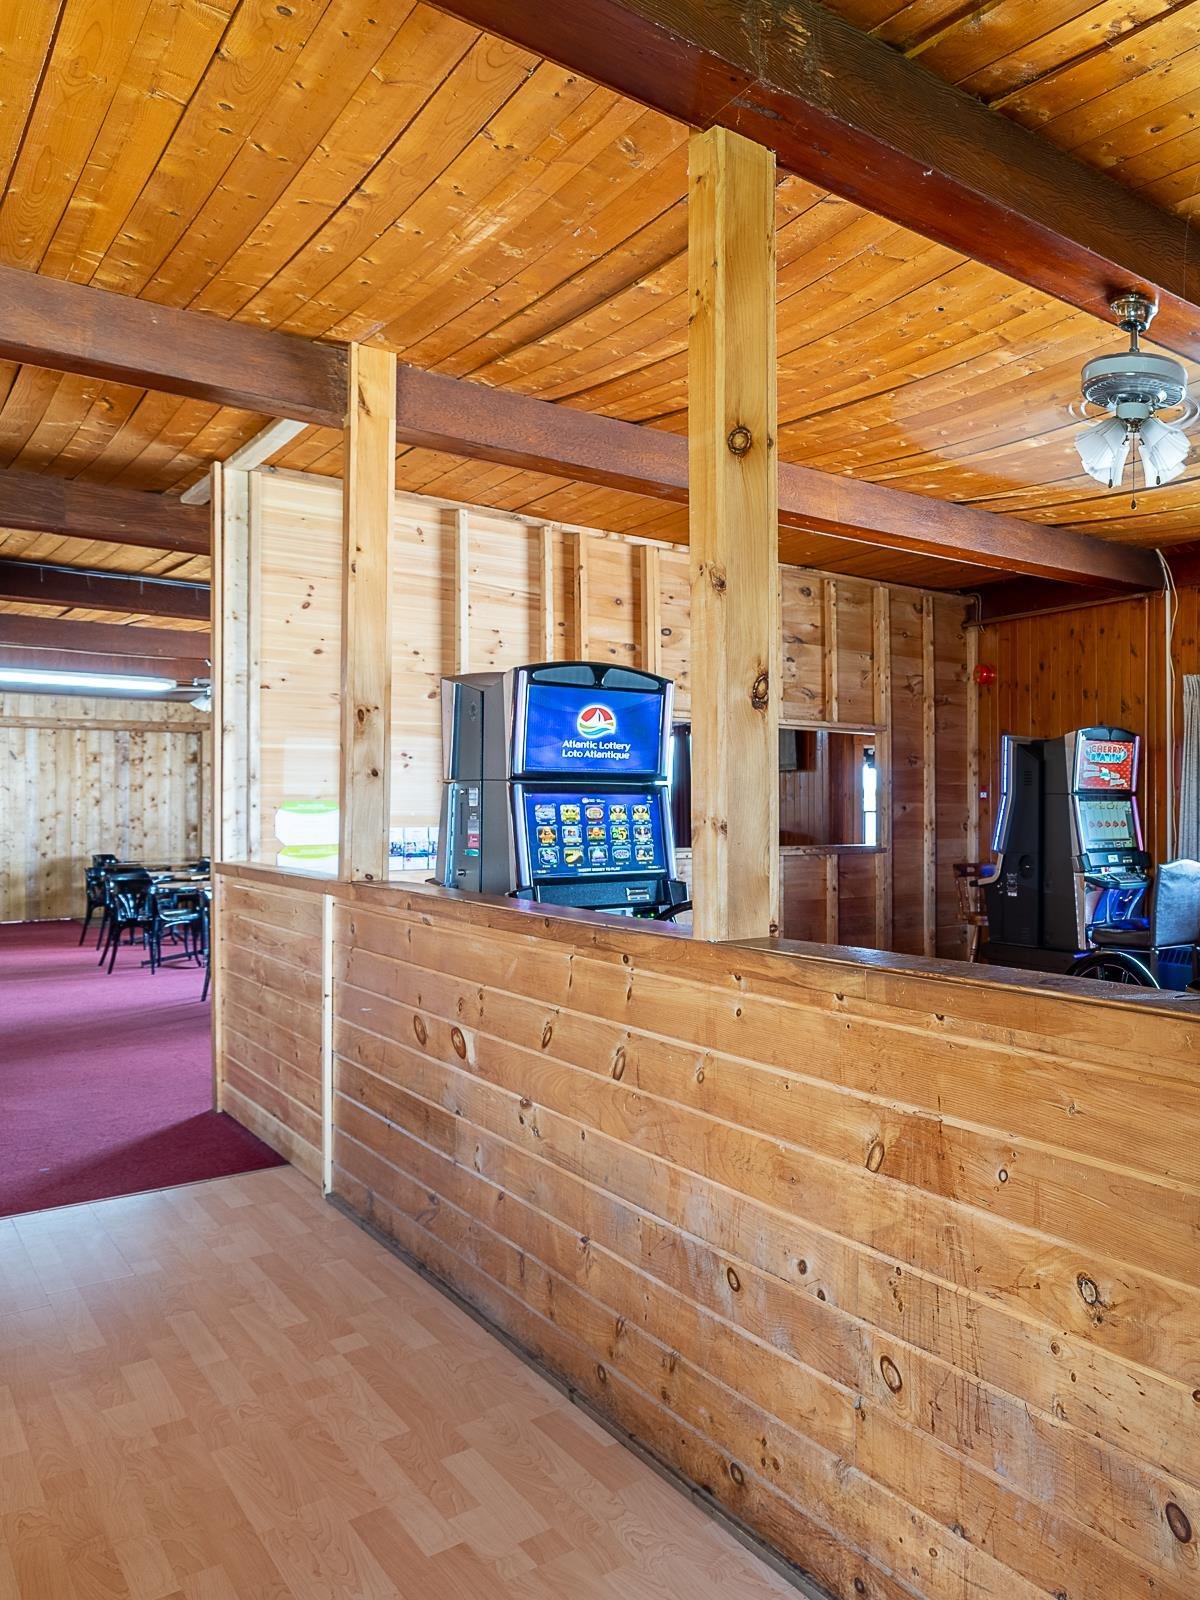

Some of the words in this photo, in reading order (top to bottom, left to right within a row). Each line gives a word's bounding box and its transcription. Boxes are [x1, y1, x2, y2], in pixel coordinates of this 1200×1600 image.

[561, 740, 598, 750] Atlantic
[599, 741, 631, 752] Lottery
[1091, 745, 1123, 754] CHERRY
[561, 749, 583, 758] Loto
[583, 750, 630, 761] Atlantique
